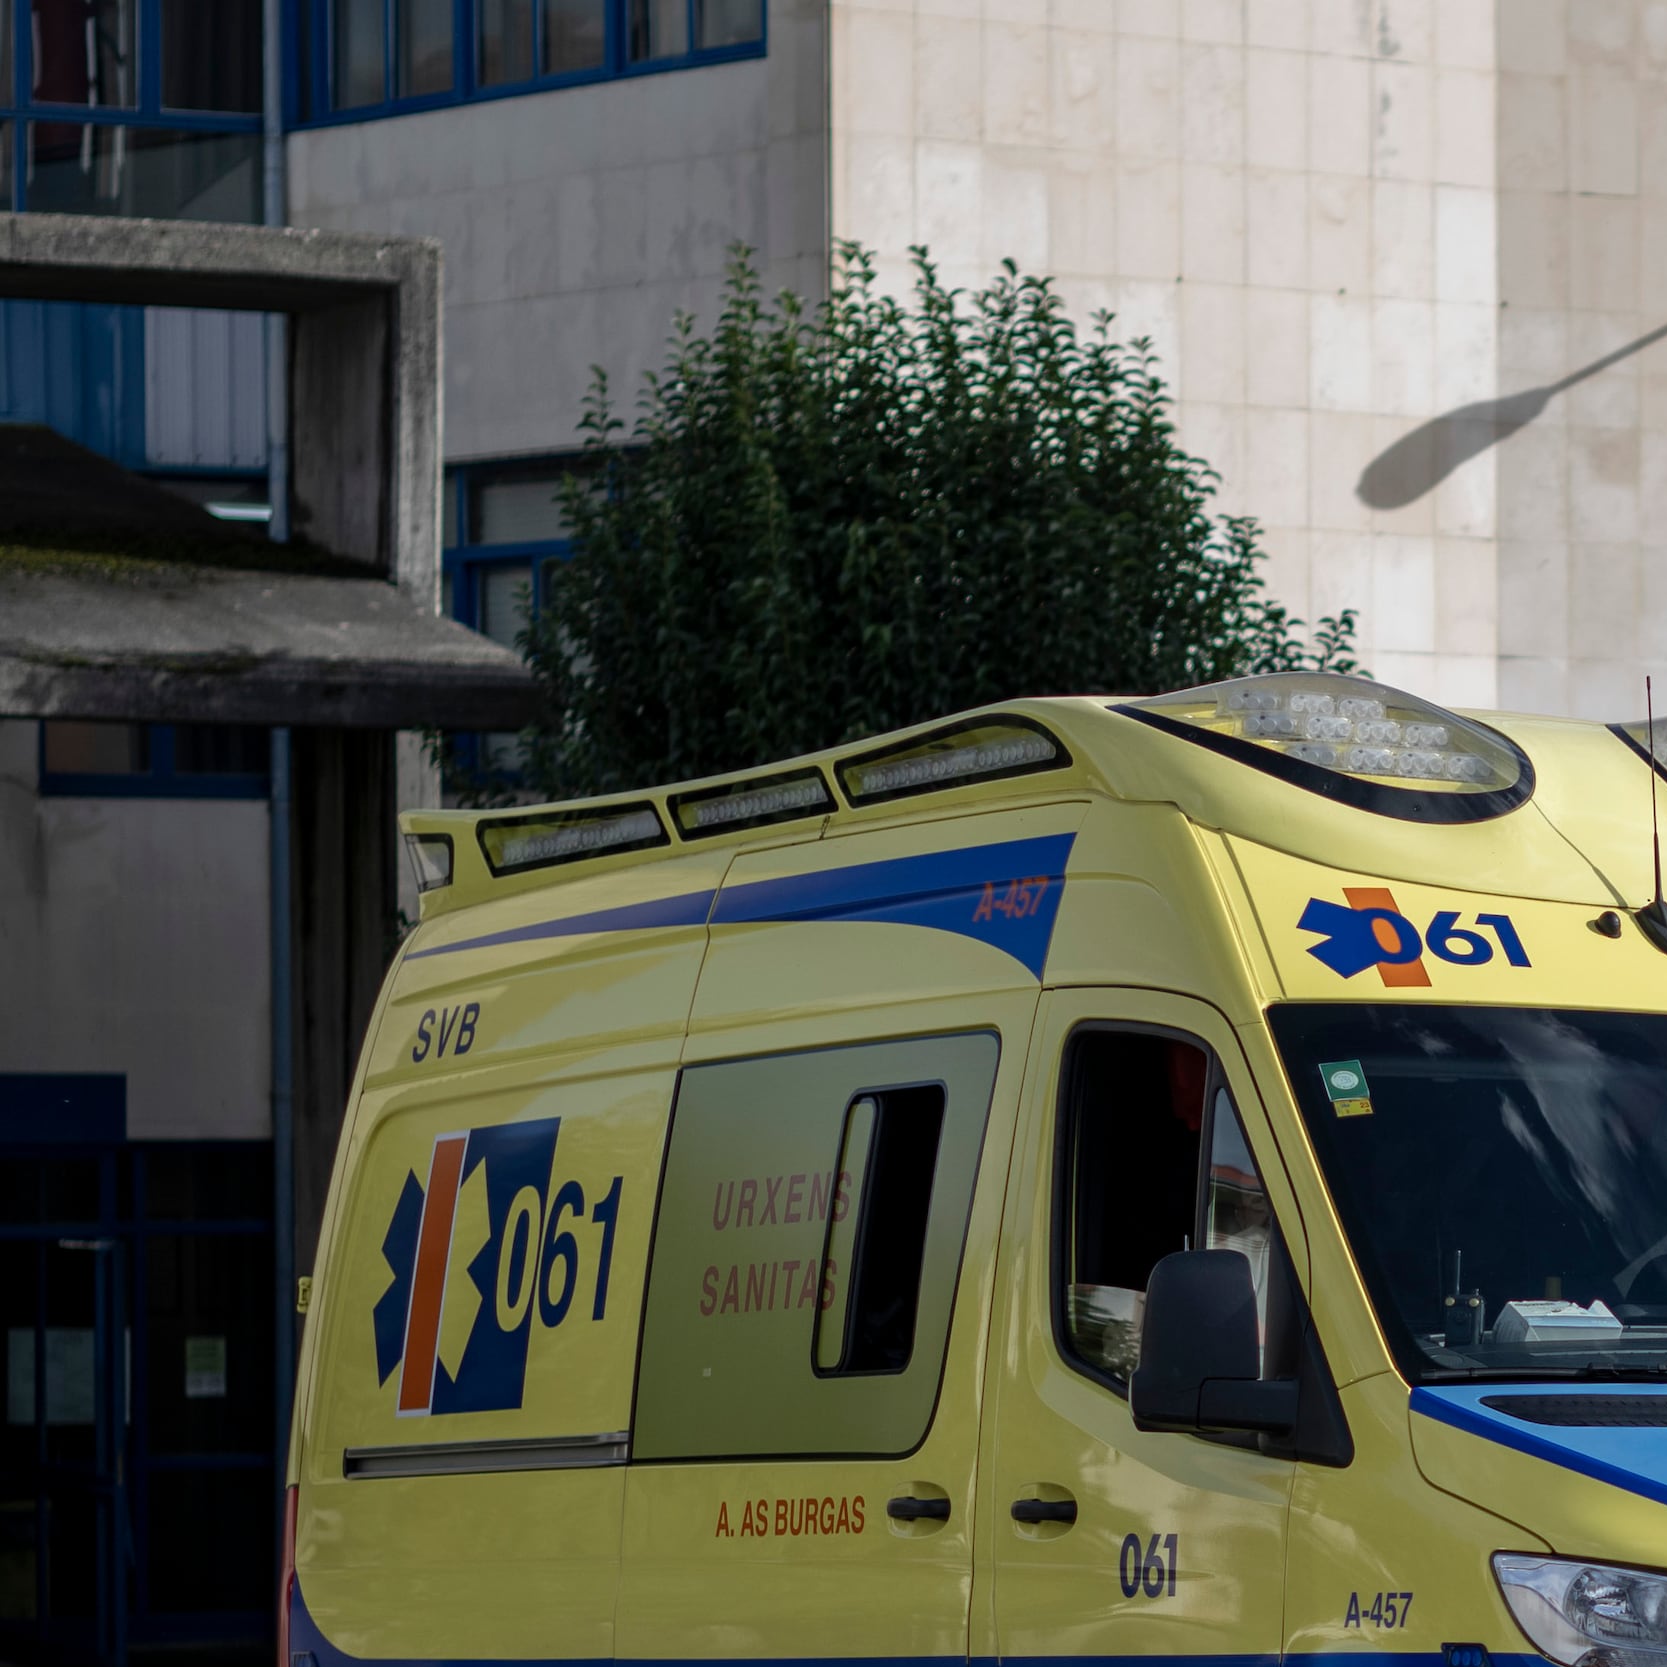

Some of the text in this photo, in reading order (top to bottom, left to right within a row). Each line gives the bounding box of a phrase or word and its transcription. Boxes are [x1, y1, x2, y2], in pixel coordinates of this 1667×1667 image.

[971, 873, 1049, 923] A-457
[411, 1001, 481, 1064] SVB
[495, 1175, 624, 1333] 061
[715, 1495, 866, 1538] A. AS BURGAS
[1119, 1532, 1179, 1599] 061
[1343, 1591, 1414, 1629] A-457
